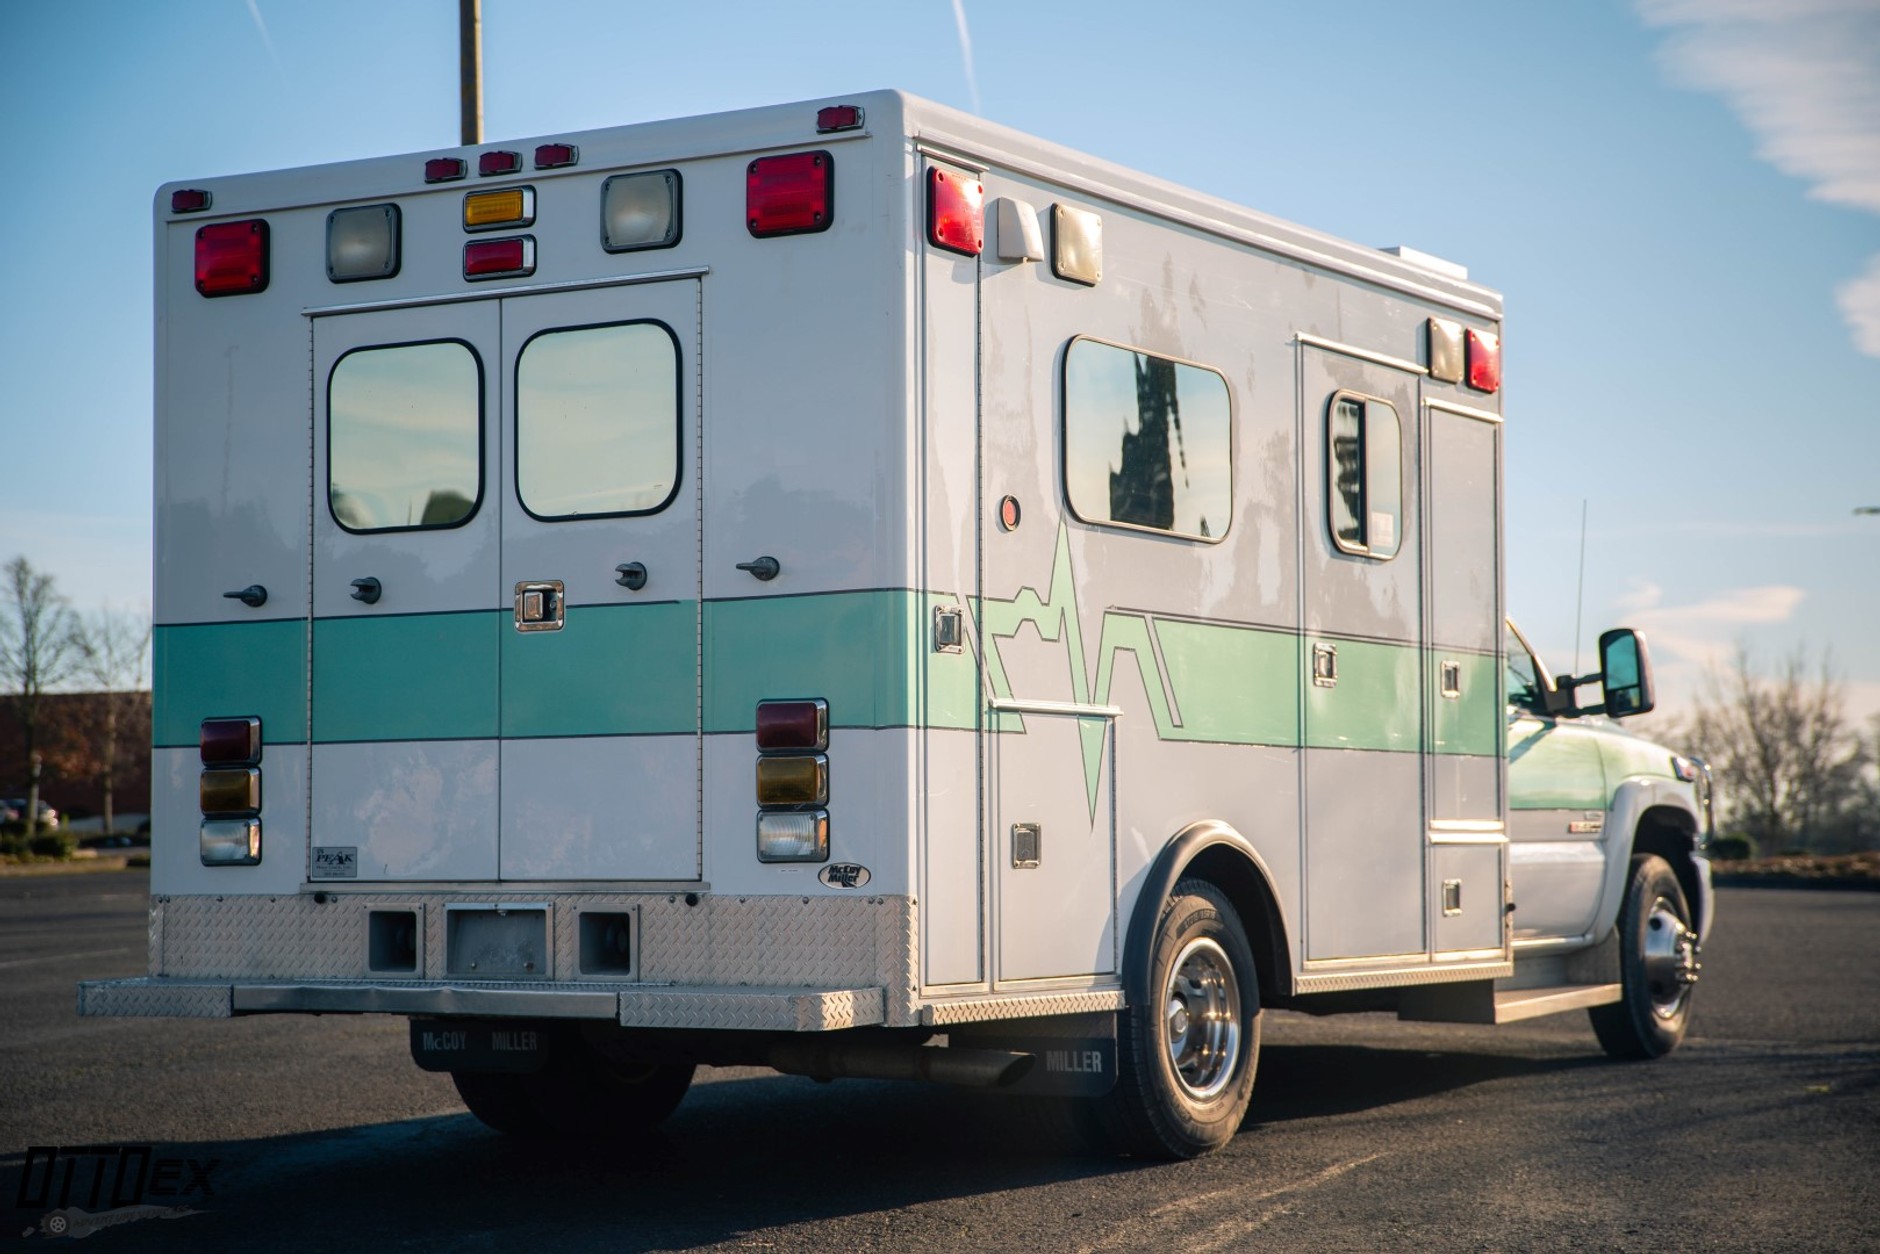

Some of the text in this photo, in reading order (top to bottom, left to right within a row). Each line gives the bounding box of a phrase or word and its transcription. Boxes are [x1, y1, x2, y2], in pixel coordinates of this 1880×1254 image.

[828, 865, 862, 876] McCoy
[828, 873, 859, 883] Miller
[492, 1031, 537, 1051] MILLER
[1046, 1050, 1102, 1073] MILLER
